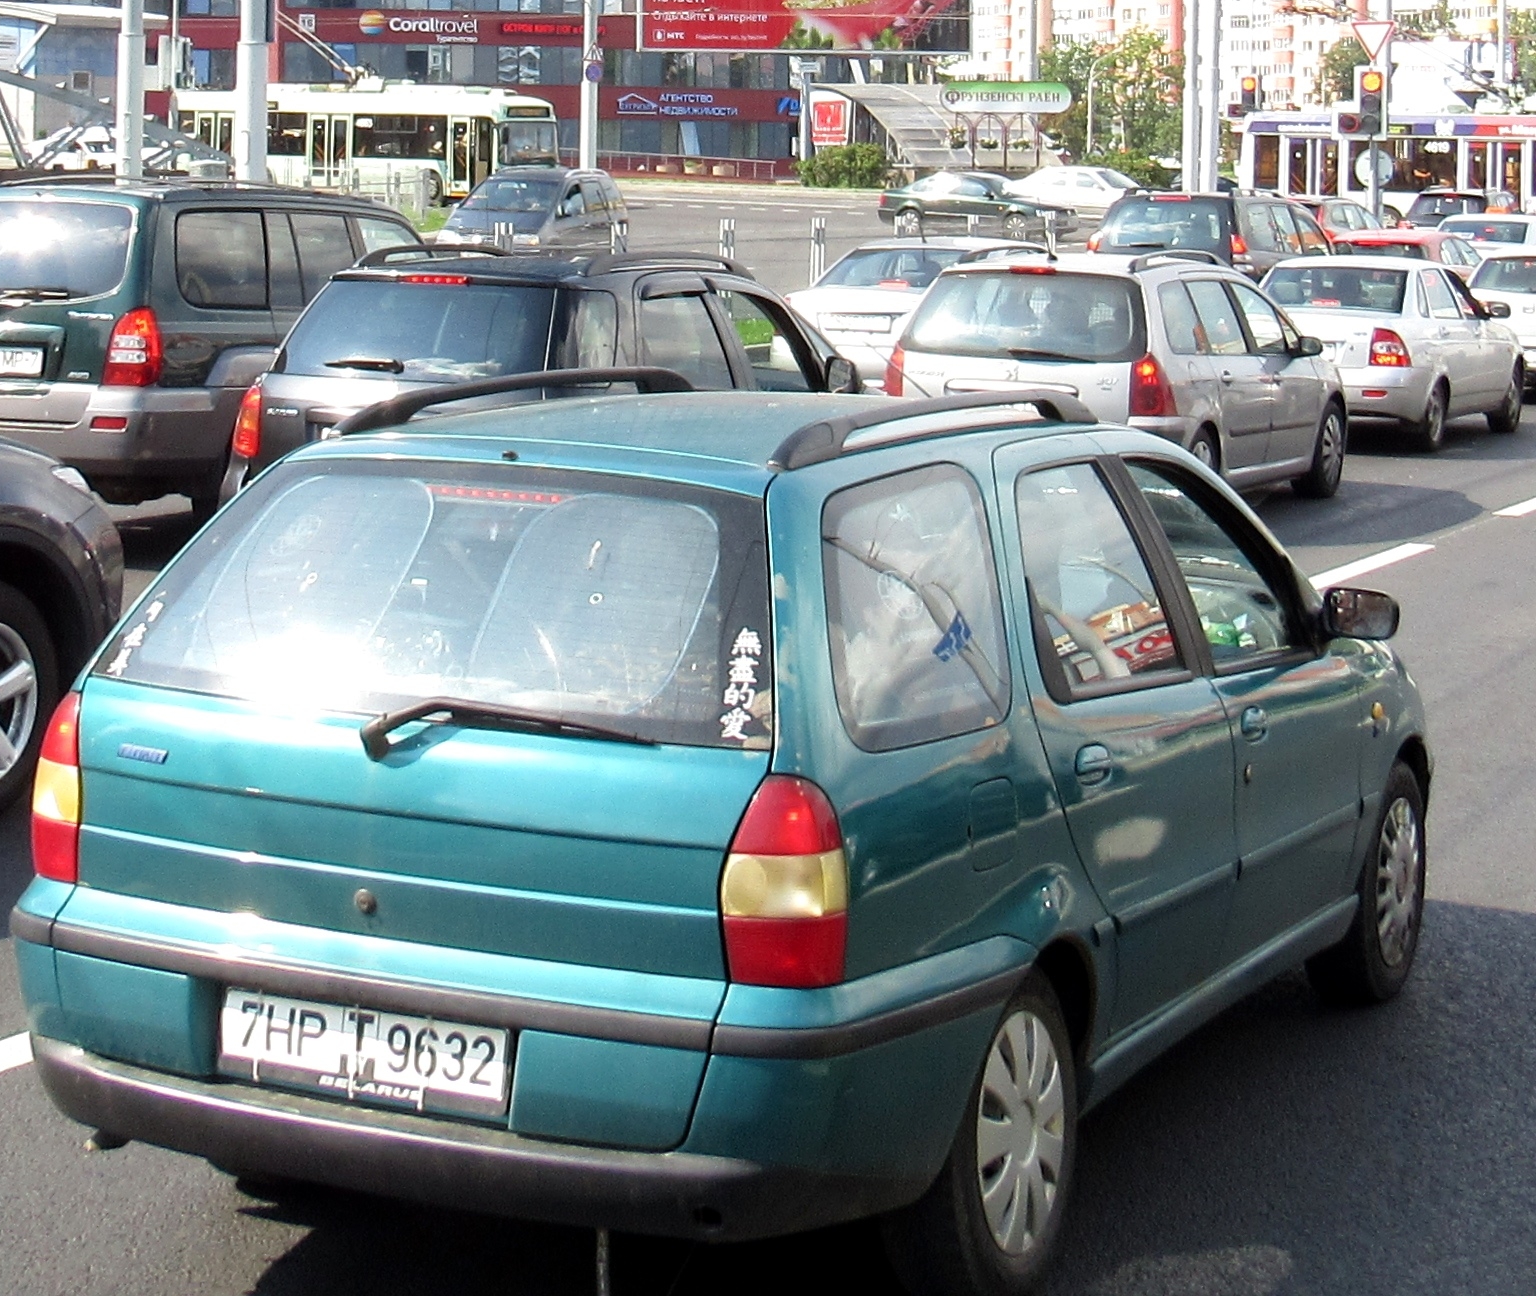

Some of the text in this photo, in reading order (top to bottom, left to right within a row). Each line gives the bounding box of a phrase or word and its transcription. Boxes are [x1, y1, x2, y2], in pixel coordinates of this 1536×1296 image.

[667, 32, 685, 40] МТС
[659, 94, 713, 103] АГЕНТСТВО
[945, 88, 1024, 104] ФРУНЗЕНСКІ
[659, 106, 738, 116] НЕДВИЖИМОСТИ
[1424, 141, 1450, 154] 4619
